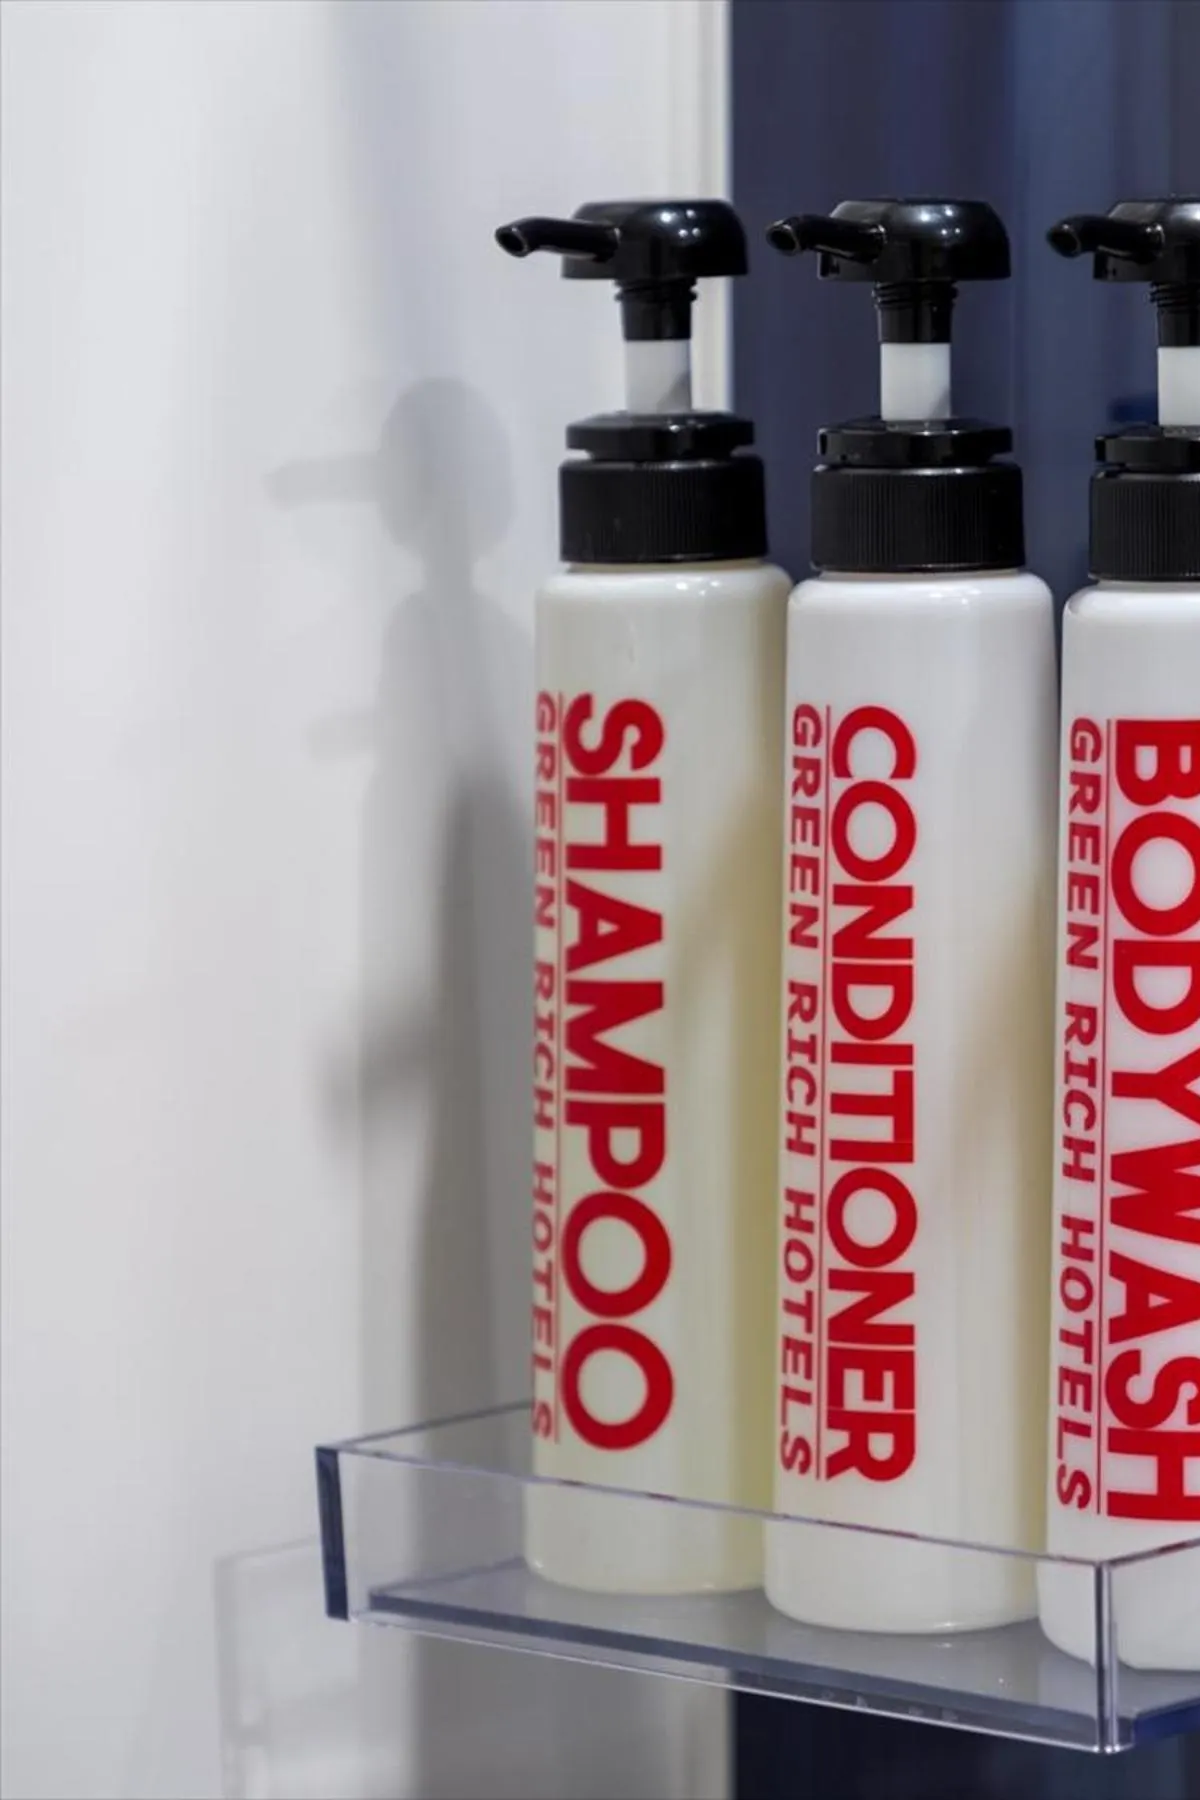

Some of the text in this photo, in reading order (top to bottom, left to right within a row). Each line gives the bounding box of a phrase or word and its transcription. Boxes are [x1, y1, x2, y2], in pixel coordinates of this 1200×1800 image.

[534, 961, 555, 1130] RICH
[535, 691, 557, 929] GREEN
[562, 693, 673, 1450] SHAMPOO
[780, 702, 822, 1476] GREEN RICH HOTELS
[826, 705, 918, 1483] CONDITIONER
[1056, 717, 1102, 1511] GREEN RICH HOTELS
